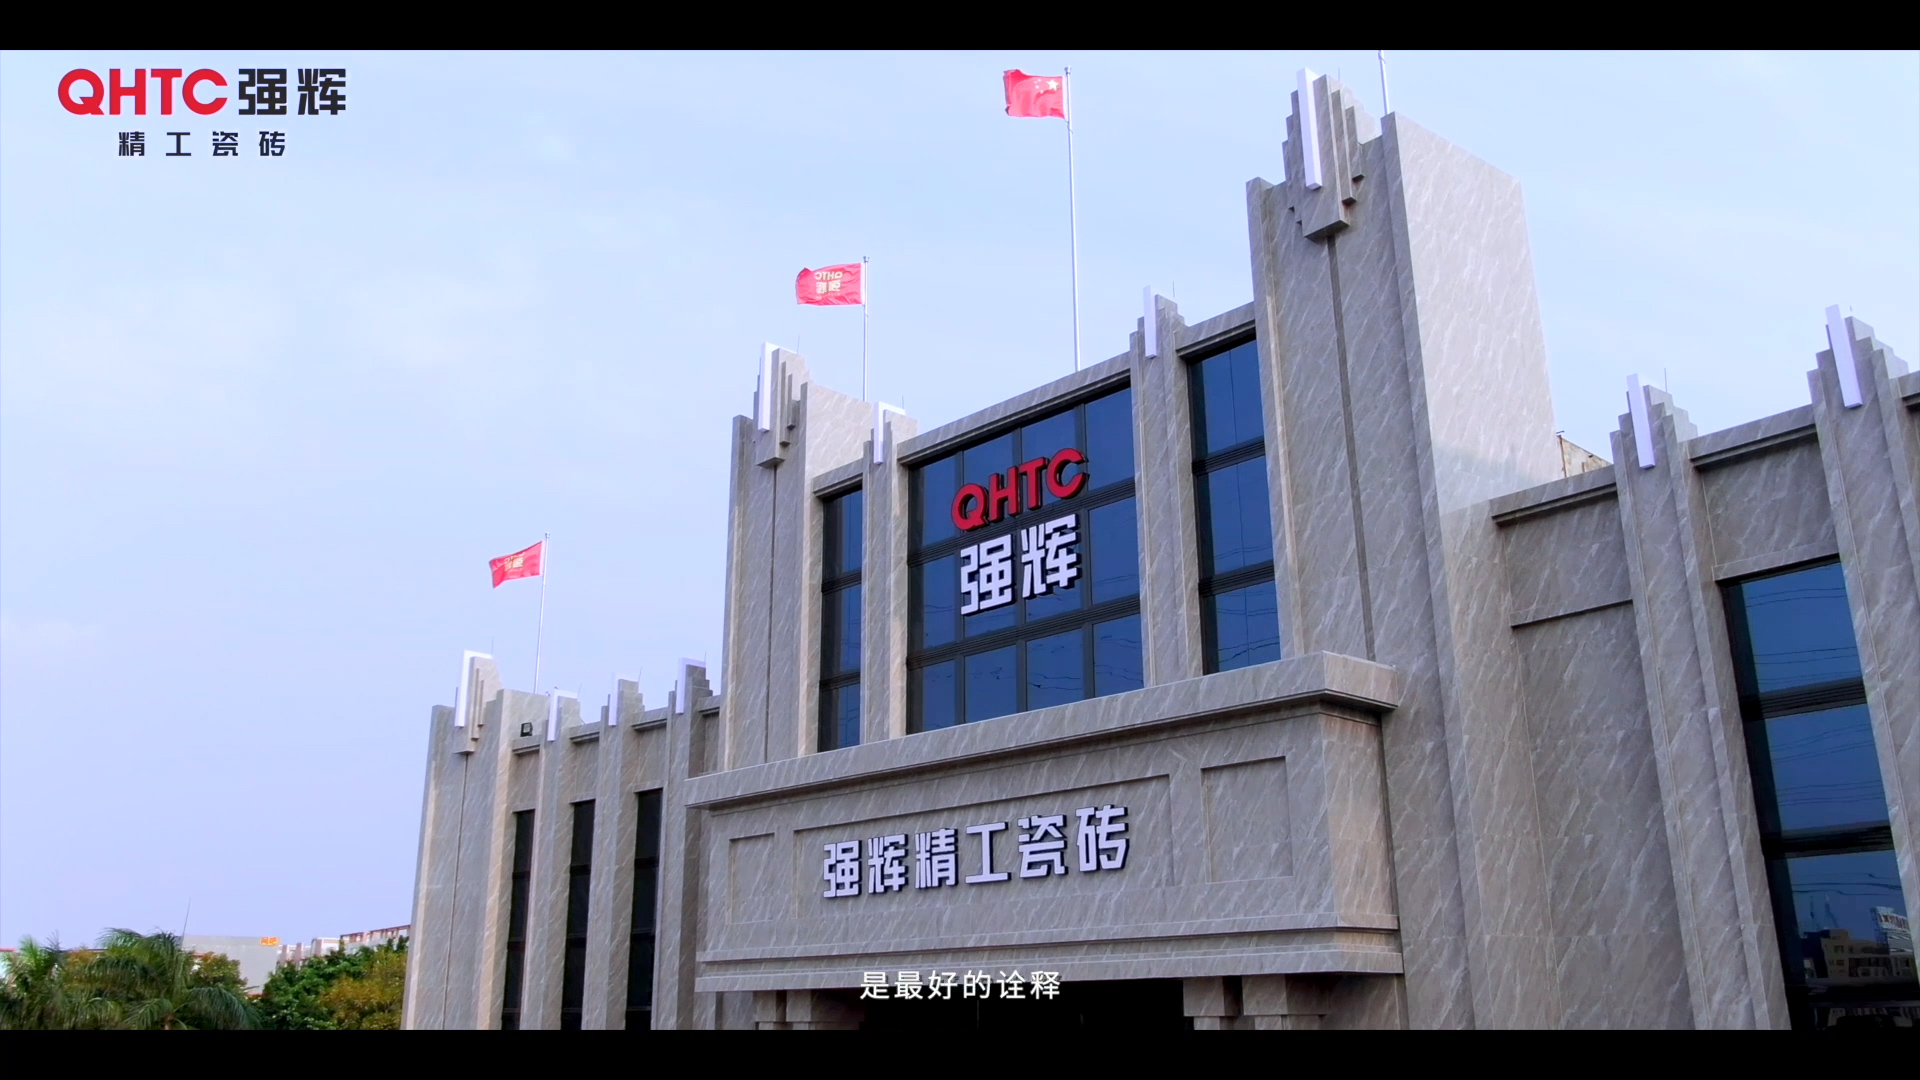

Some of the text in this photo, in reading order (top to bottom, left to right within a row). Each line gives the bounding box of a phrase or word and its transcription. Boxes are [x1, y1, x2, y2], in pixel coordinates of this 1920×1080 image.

[952, 448, 1088, 531] QHTC
[960, 513, 1078, 615] 强辉
[823, 804, 1128, 898] 强辉精工瓷砖
